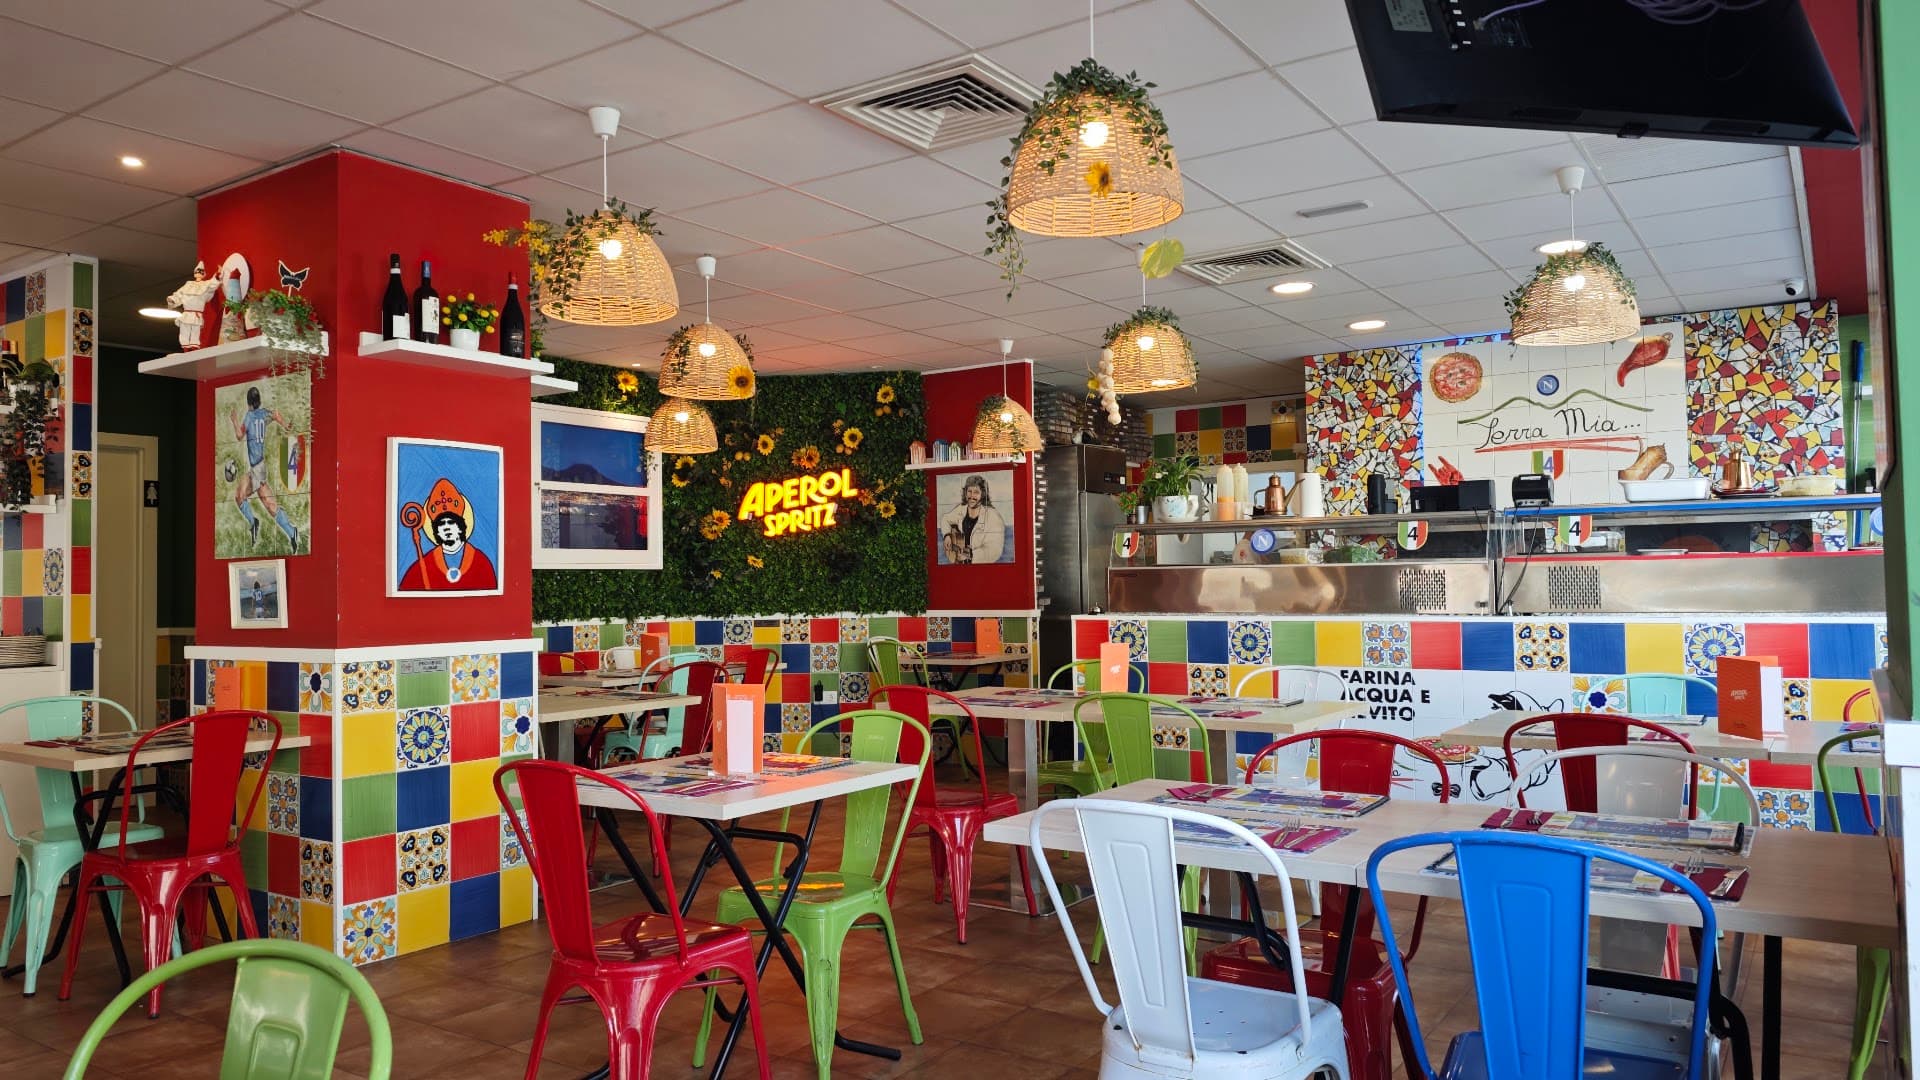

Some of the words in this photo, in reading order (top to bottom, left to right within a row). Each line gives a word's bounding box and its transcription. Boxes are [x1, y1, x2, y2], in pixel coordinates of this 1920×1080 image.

[255, 419, 264, 443] 10
[288, 443, 298, 475] 4
[1542, 456, 1555, 473] 4
[738, 468, 858, 520] APEROL
[764, 502, 837, 537] SPRITZ
[1407, 526, 1418, 541] 4
[1569, 521, 1581, 537] 4
[1122, 537, 1131, 550] 4
[1257, 535, 1269, 548] N
[1340, 670, 1416, 685] FARINA
[1340, 687, 1413, 703] ACQUA
[1421, 690, 1430, 703] E
